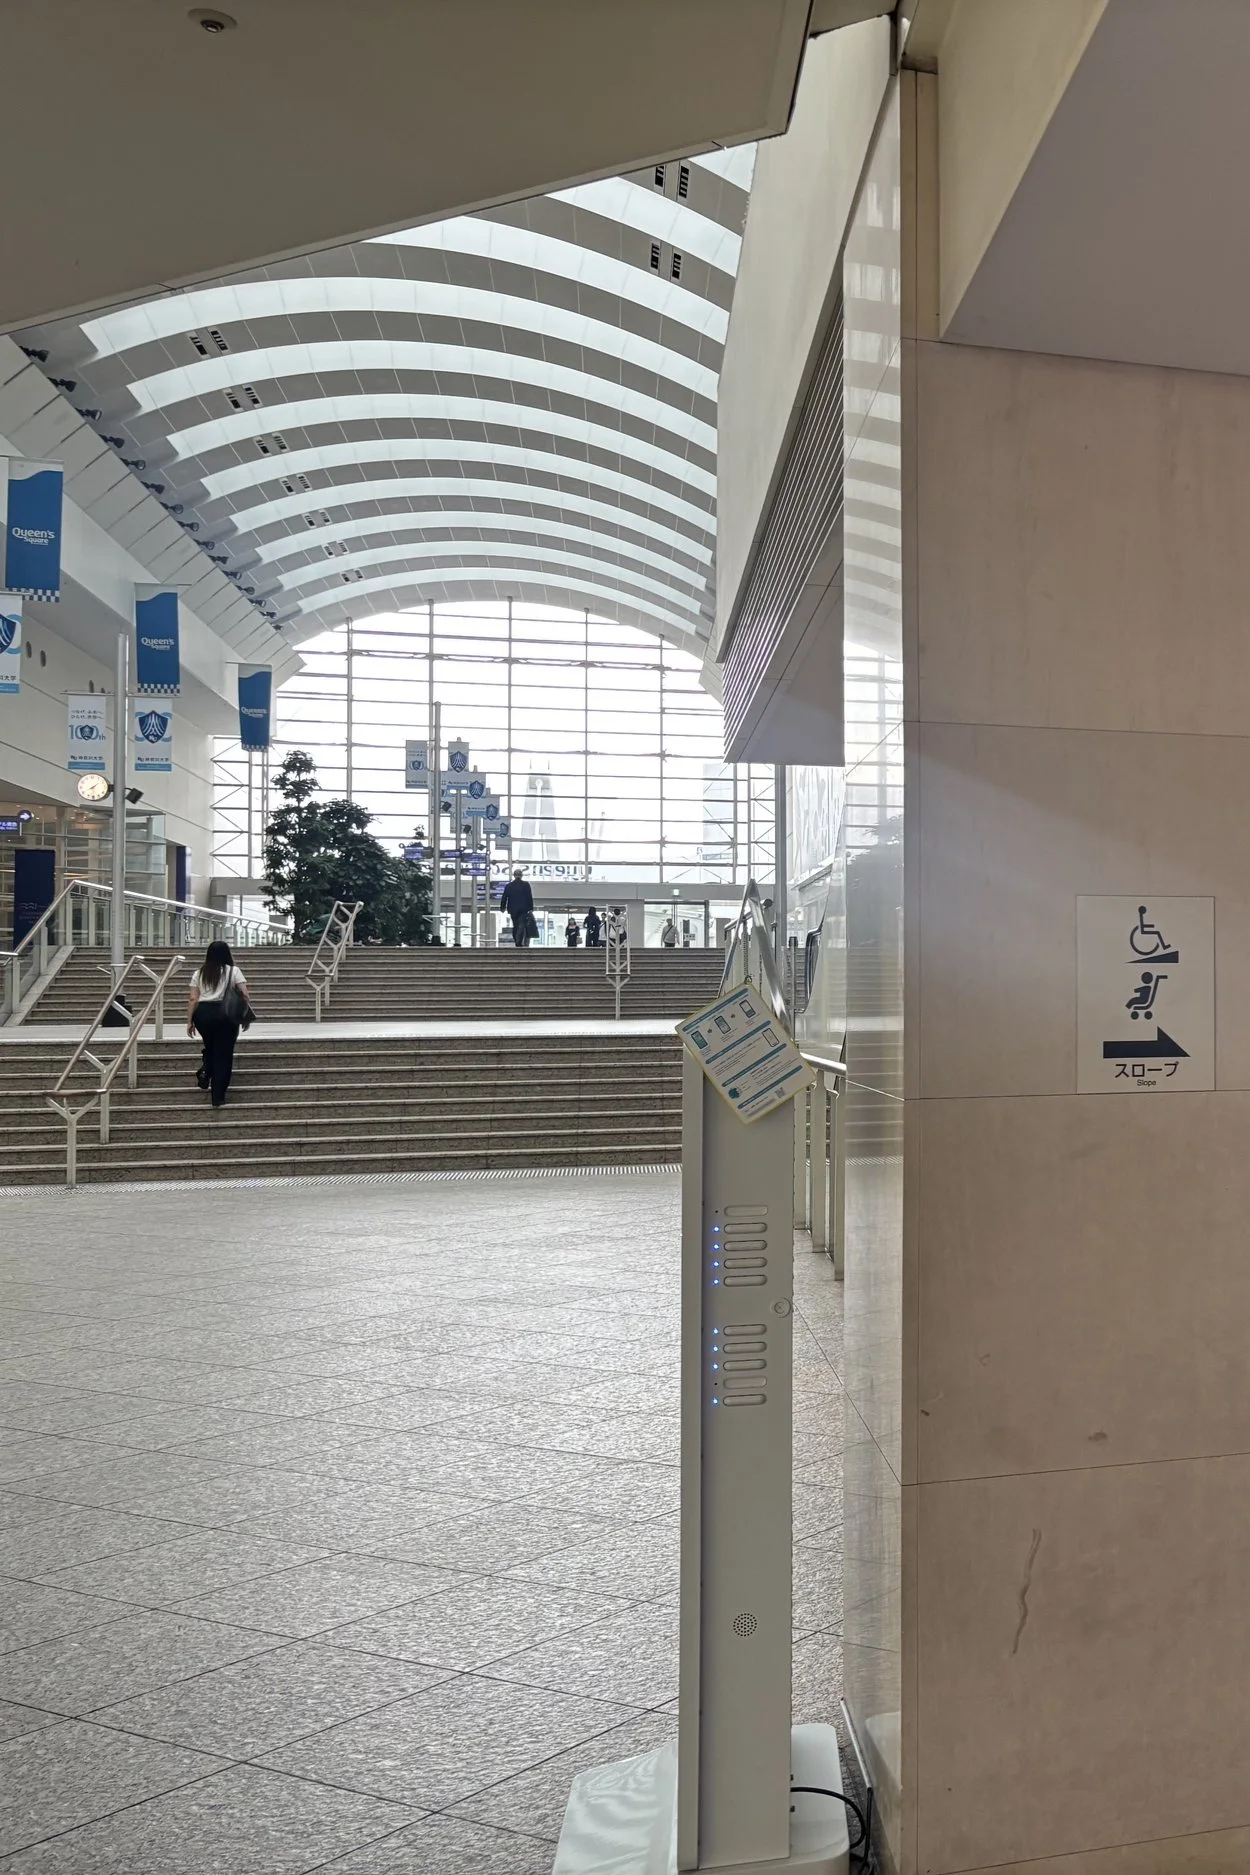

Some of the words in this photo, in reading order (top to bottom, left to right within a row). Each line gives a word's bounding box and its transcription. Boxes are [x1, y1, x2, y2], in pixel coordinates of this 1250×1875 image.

[12, 527, 56, 539] Queen's
[141, 637, 175, 647] Queen's
[1115, 1061, 1179, 1079] スロープ
[1137, 1079, 1157, 1088] Slope
